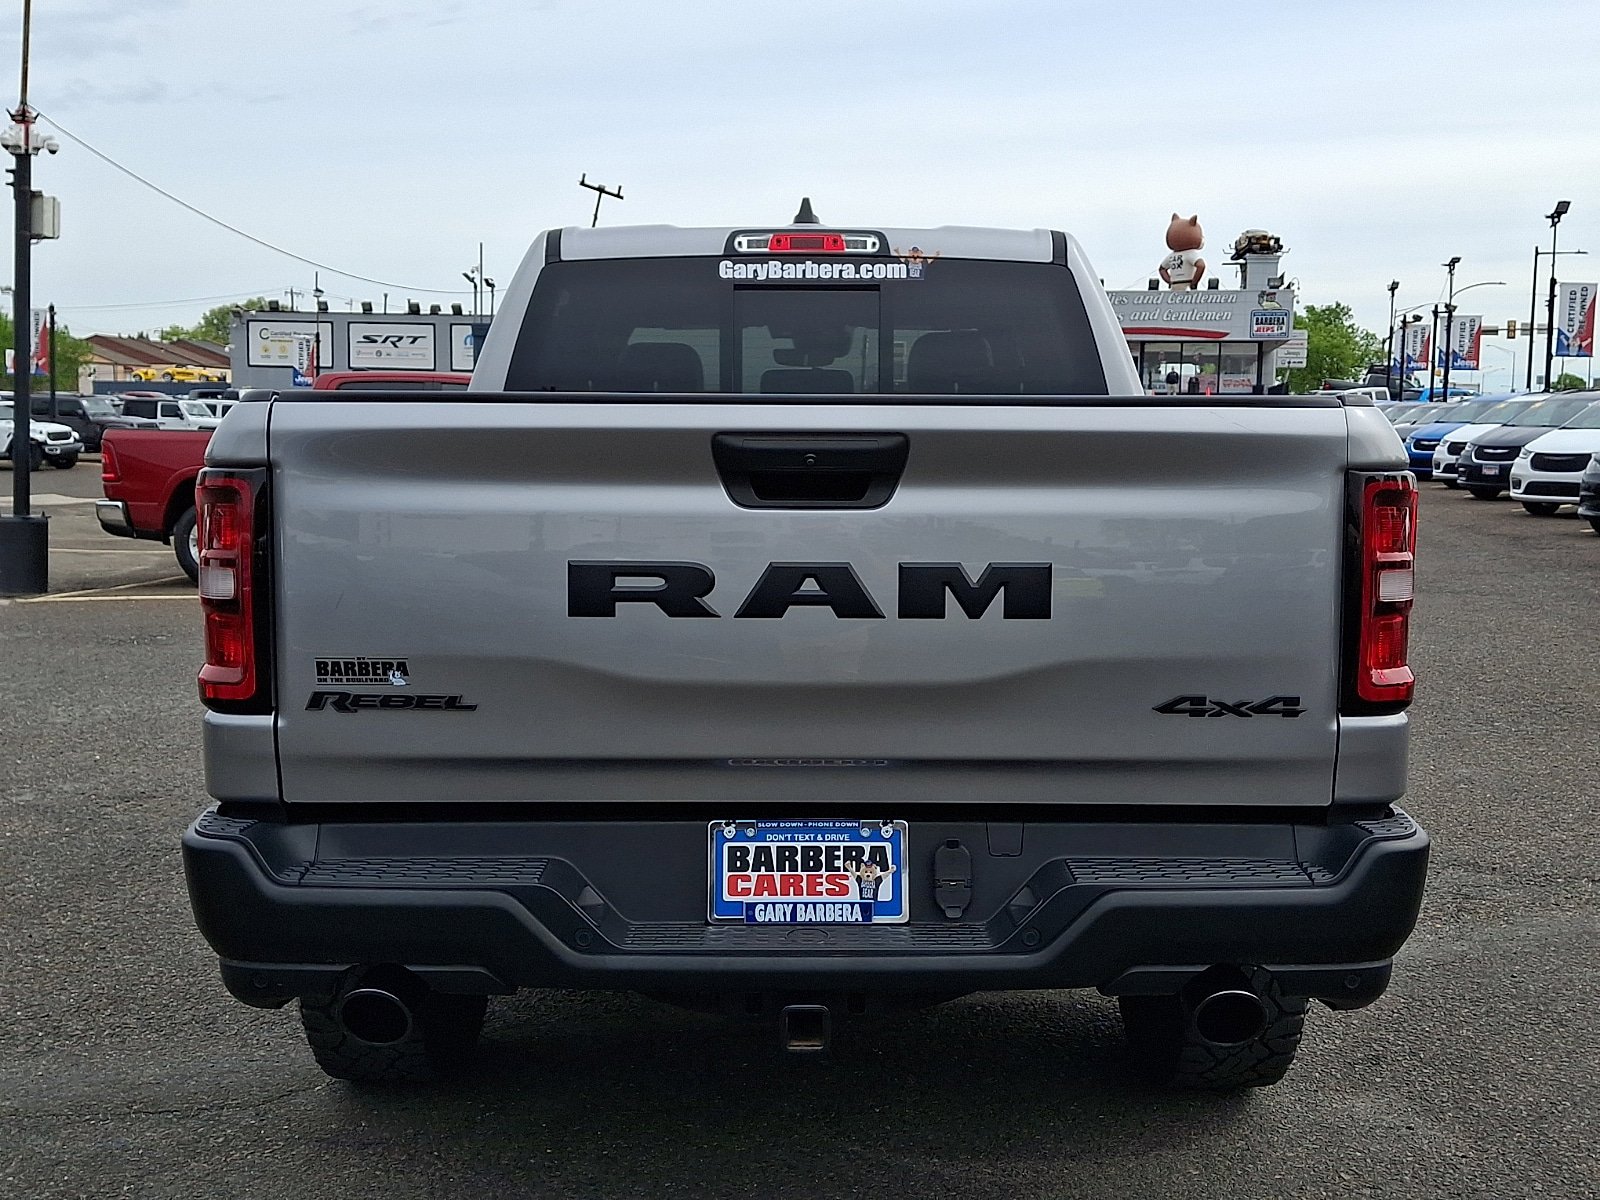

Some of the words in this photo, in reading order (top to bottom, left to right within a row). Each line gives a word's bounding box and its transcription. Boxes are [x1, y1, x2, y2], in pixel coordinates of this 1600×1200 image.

[719, 260, 907, 280] GaryBarbera.com
[1133, 293, 1164, 304] and
[1167, 291, 1237, 304] Gentlemen
[1130, 309, 1159, 320] and
[1162, 308, 1232, 321] Gentlemen
[1567, 289, 1577, 333] CERTIFIED
[1578, 286, 1589, 335] PRE-OWNED
[1254, 316, 1286, 326] BARBERA
[356, 334, 428, 349] SRT
[1407, 360, 1428, 369] Jeep
[1453, 358, 1478, 369] Jeep
[567, 560, 1053, 619] RAM
[315, 661, 410, 677] BARBERA
[305, 690, 479, 713] REBEL
[1152, 694, 1308, 718] 4x4
[766, 833, 791, 841] DON'T
[794, 833, 813, 841] TEXT
[816, 833, 823, 841] &
[825, 833, 850, 841] DRIVE
[727, 845, 890, 873] BARBERA
[727, 873, 850, 897] CARES
[754, 903, 794, 922] GARY
[796, 903, 862, 922] BARBERA
